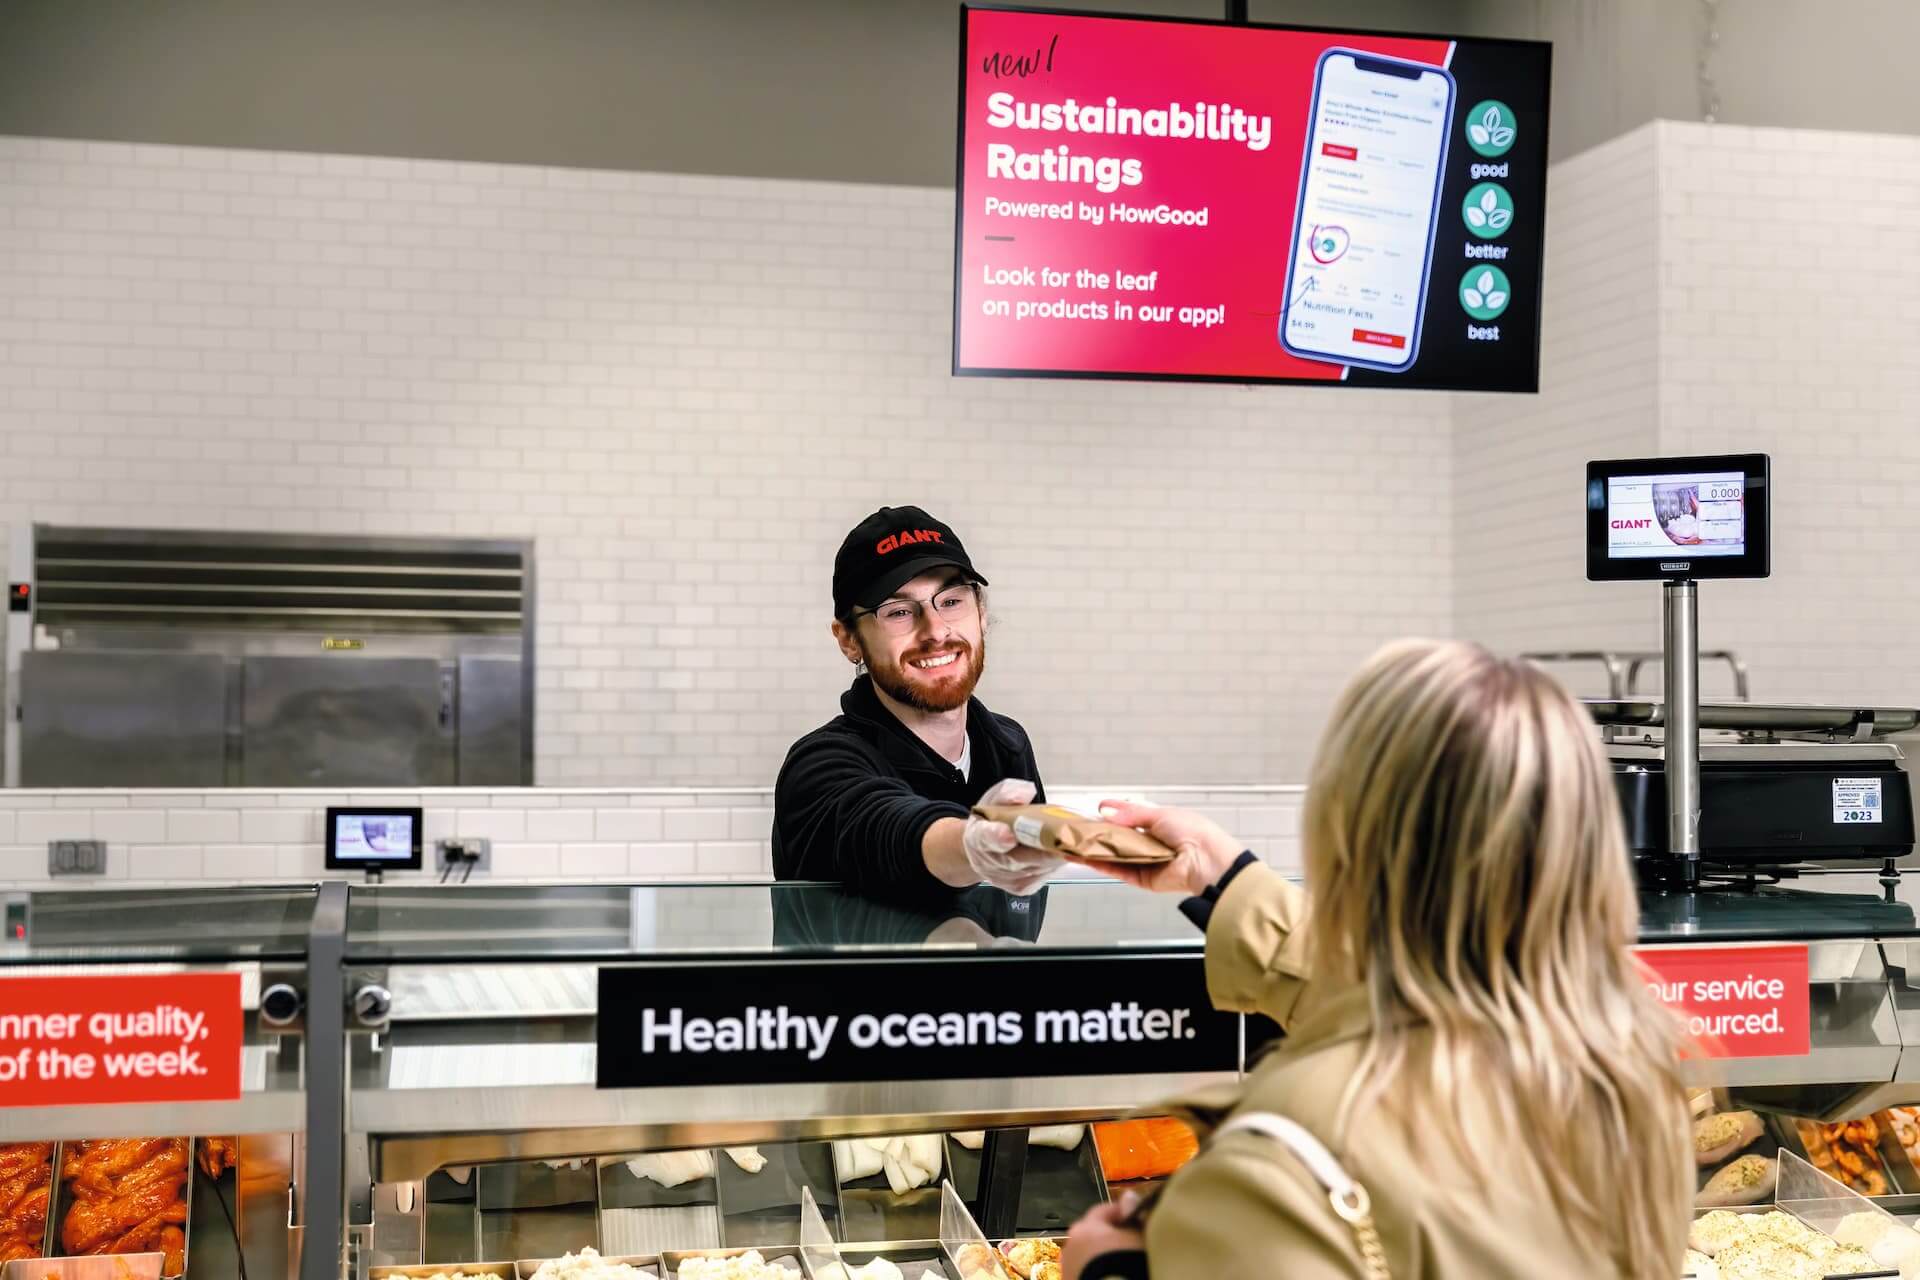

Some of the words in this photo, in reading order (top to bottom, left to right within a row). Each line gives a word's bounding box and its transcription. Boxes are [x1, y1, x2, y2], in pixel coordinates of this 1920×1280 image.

[984, 34, 1059, 82] new!
[987, 93, 1271, 151] Sustainability
[987, 143, 1143, 193] Ratings
[1470, 162, 1508, 179] good
[984, 196, 1073, 220] Powered
[1079, 202, 1104, 225] by
[1110, 204, 1209, 226] HowGood
[1465, 241, 1509, 260] better
[983, 265, 1036, 287] Look
[1041, 267, 1071, 288] for
[1076, 268, 1110, 289] the
[1116, 270, 1158, 291] leaf
[982, 300, 1010, 316] on
[1016, 299, 1109, 321] products
[1115, 301, 1133, 321] in
[1138, 305, 1173, 323] our
[1179, 305, 1225, 328] app!
[1467, 324, 1501, 341] best
[1711, 488, 1740, 499] 0.000
[1611, 519, 1652, 529] GIANT
[877, 529, 942, 554] GIANT
[1693, 974, 1785, 1002] service
[88, 1005, 209, 1044] quality,
[642, 1007, 839, 1059] Healthy
[848, 1008, 1022, 1048] oceans
[1035, 1002, 1196, 1044] matter.
[0, 1047, 32, 1081] of
[37, 1048, 96, 1080] the
[103, 1044, 208, 1078] week.
